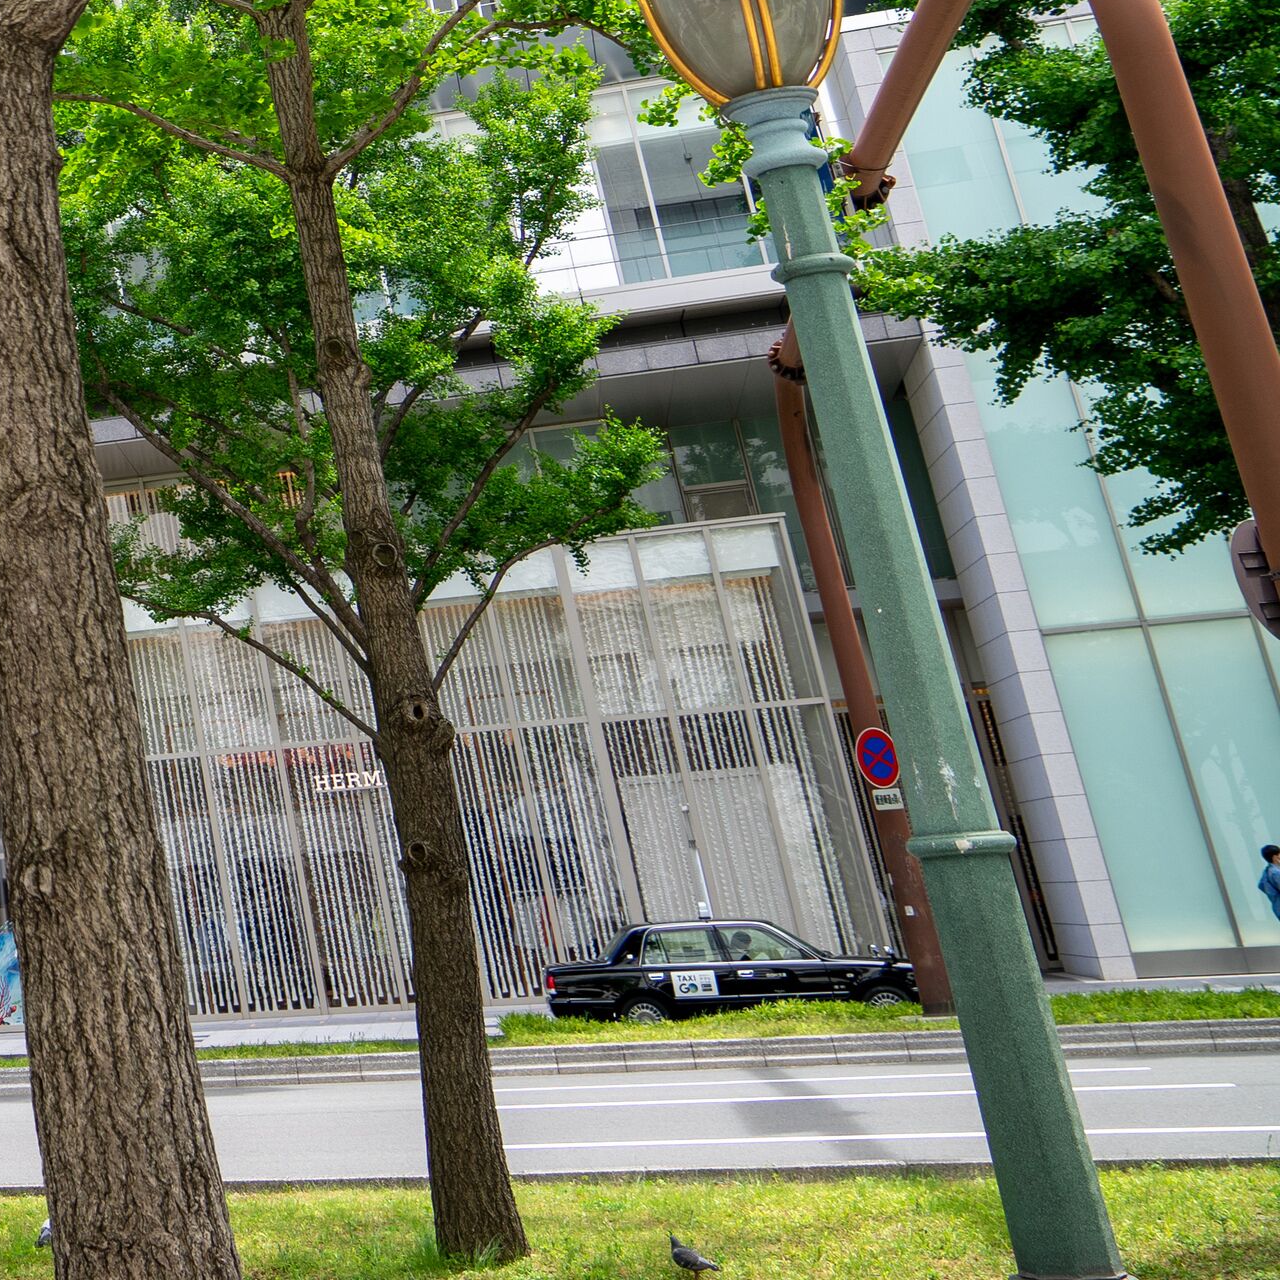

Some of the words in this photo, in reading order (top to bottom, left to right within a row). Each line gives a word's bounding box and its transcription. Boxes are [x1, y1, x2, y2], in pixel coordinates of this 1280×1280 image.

[313, 770, 383, 791] HERM
[677, 974, 697, 982] TAXI
[679, 983, 698, 994] GO
